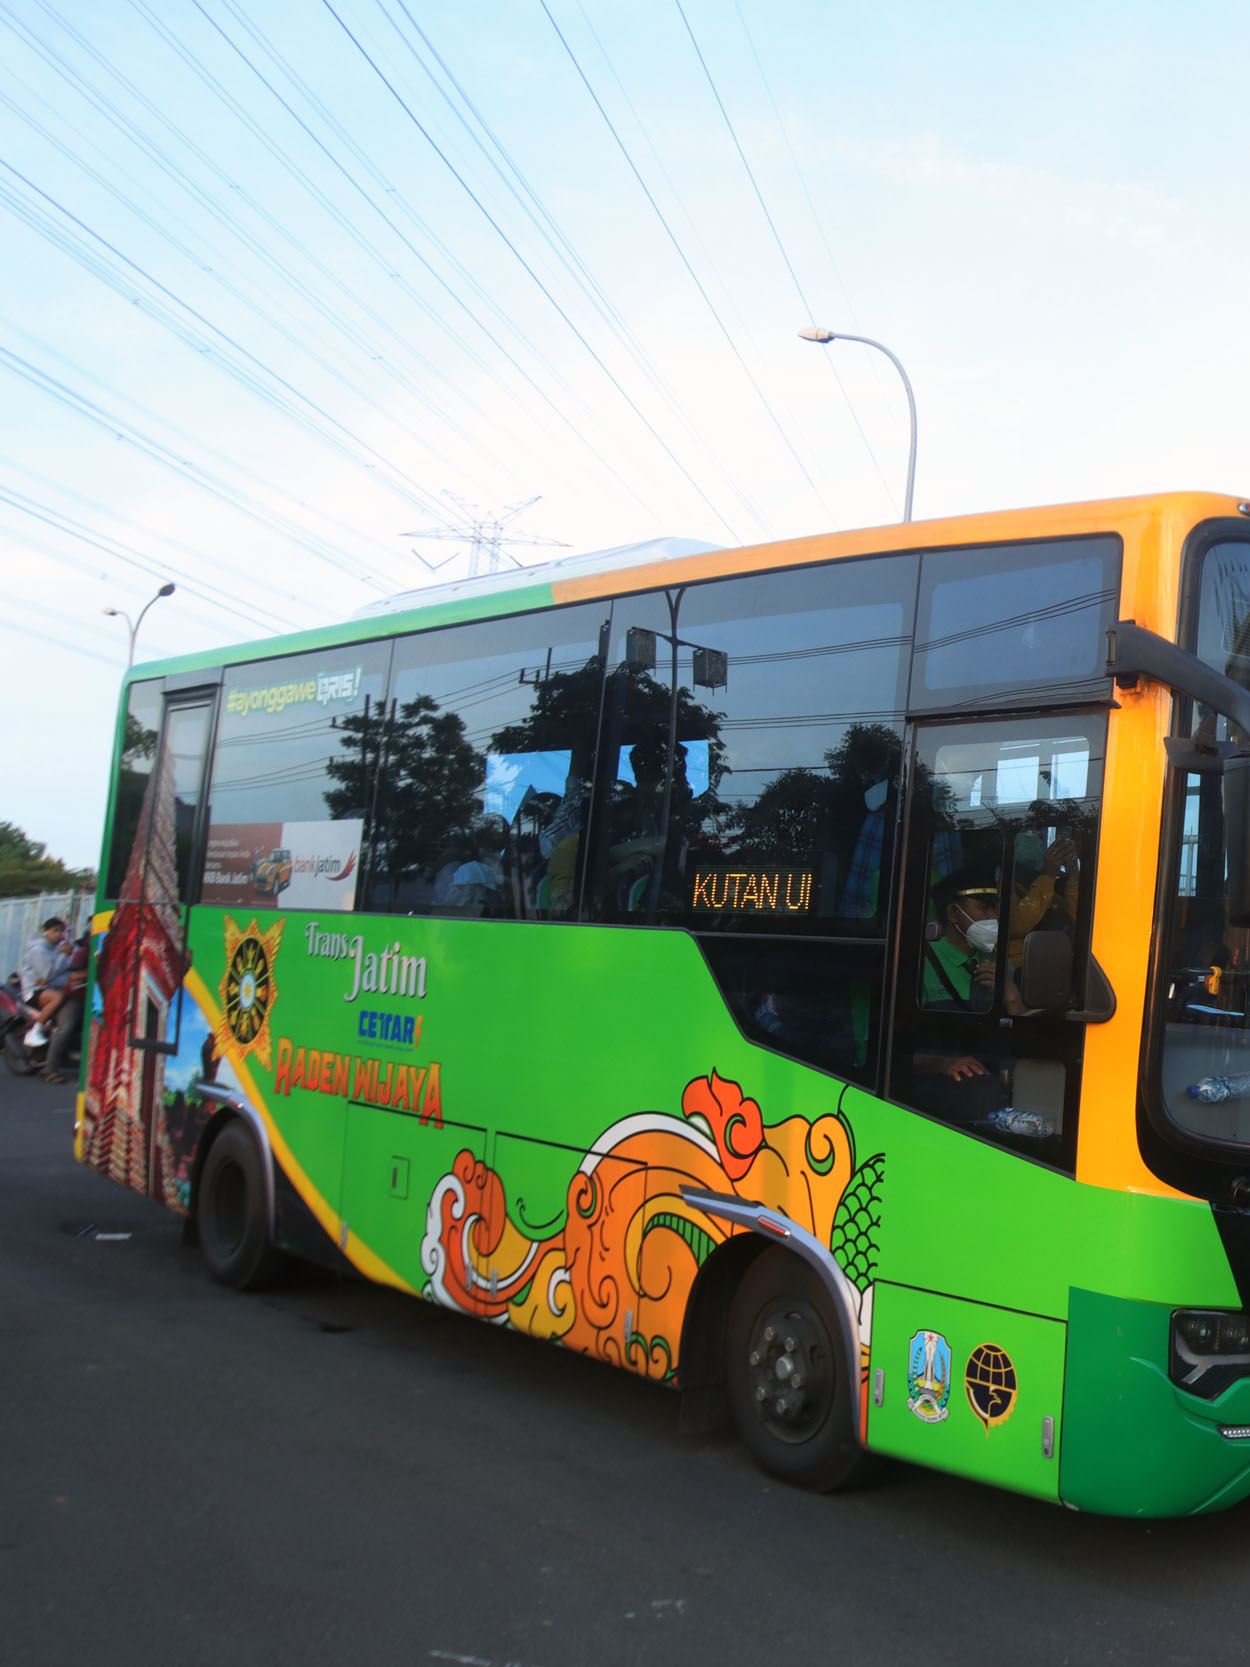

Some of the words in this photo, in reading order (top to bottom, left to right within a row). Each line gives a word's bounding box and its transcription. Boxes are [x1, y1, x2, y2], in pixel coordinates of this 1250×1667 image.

[693, 873, 779, 909] KUTAN
[305, 921, 348, 961] Trans
[344, 935, 427, 1002] Jatim
[274, 1036, 351, 1097] RADEN
[352, 1056, 444, 1129] WIJAYA
